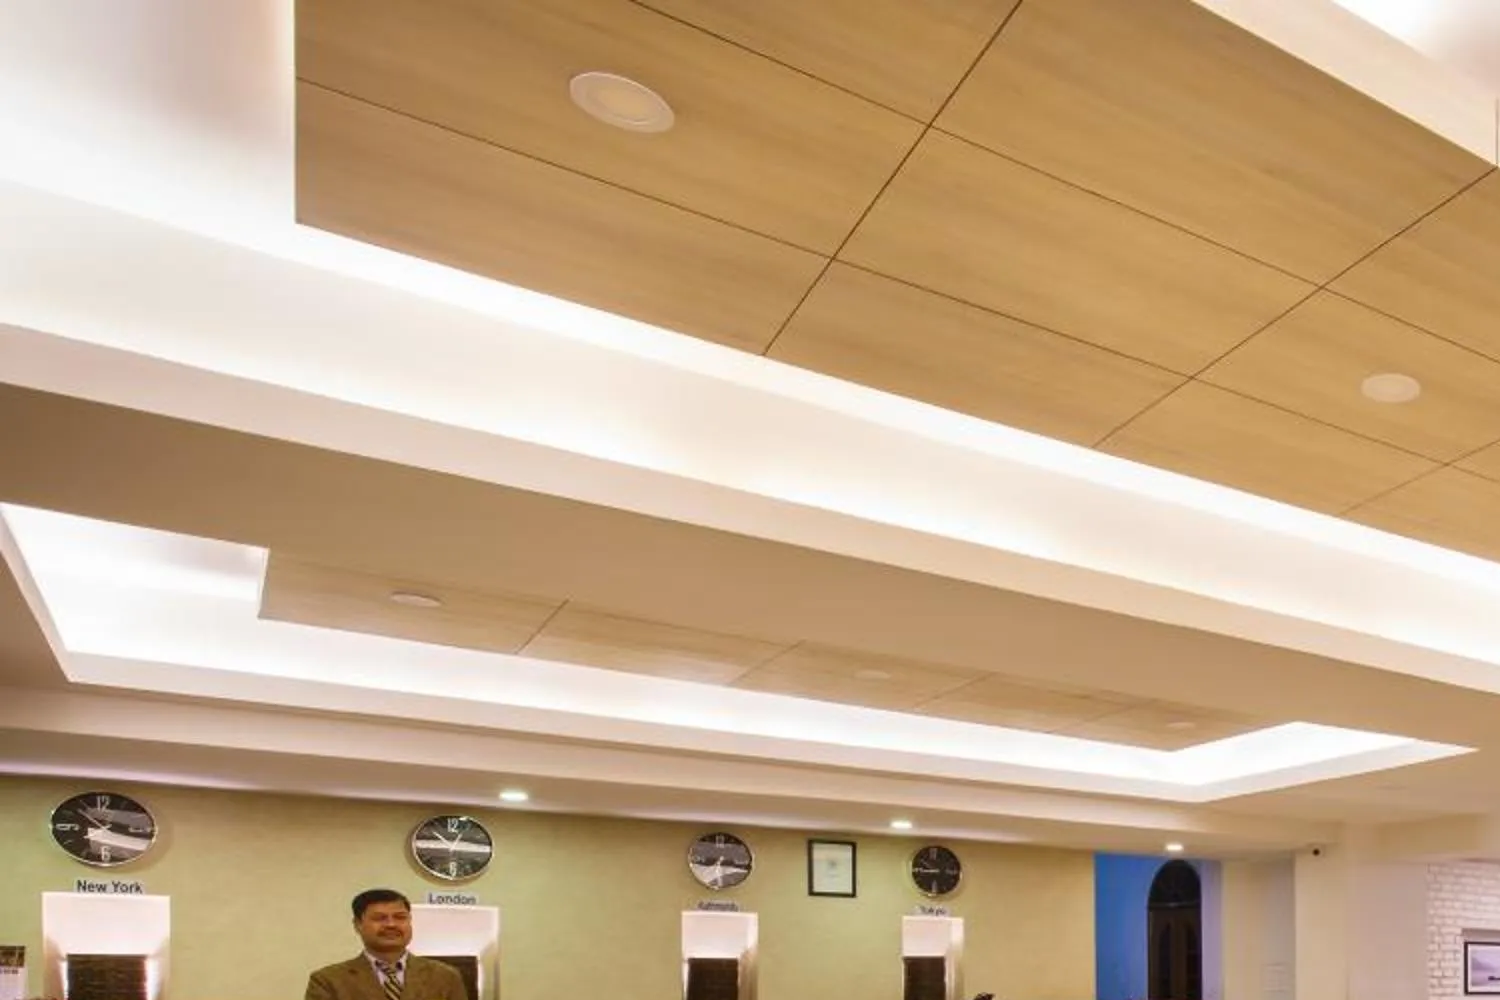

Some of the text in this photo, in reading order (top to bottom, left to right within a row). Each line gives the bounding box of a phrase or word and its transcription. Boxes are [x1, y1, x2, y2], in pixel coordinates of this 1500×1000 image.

[77, 880, 143, 894] New York
[429, 893, 476, 905] London
